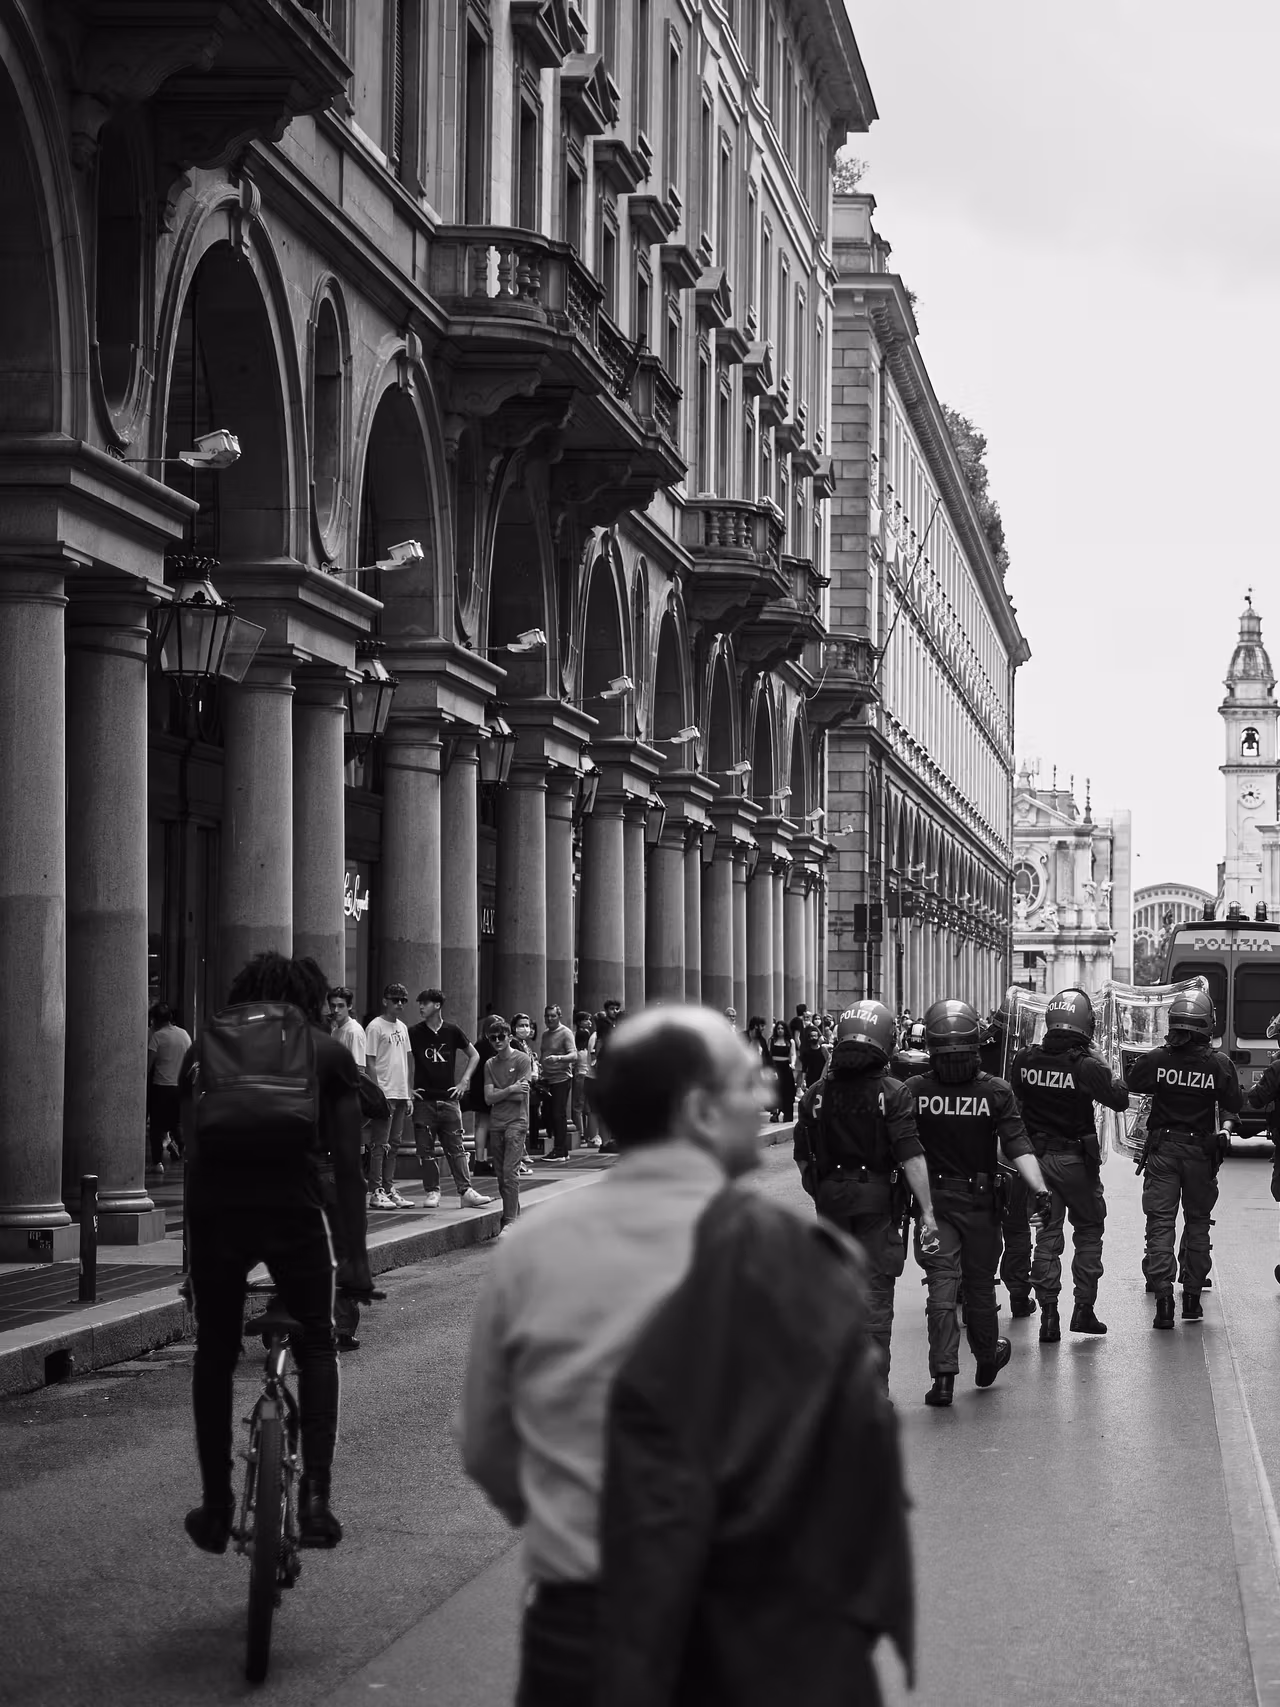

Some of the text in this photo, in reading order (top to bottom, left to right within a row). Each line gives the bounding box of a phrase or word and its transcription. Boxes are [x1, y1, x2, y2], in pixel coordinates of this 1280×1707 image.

[1193, 938, 1273, 952] POLIZIA
[1048, 1001, 1076, 1013] OLIZIA
[839, 1009, 879, 1026] POLIZIA
[1020, 1067, 1076, 1089] POLIZIA
[1156, 1067, 1215, 1089] POLIZIA
[918, 1095, 991, 1117] POLIZIA
